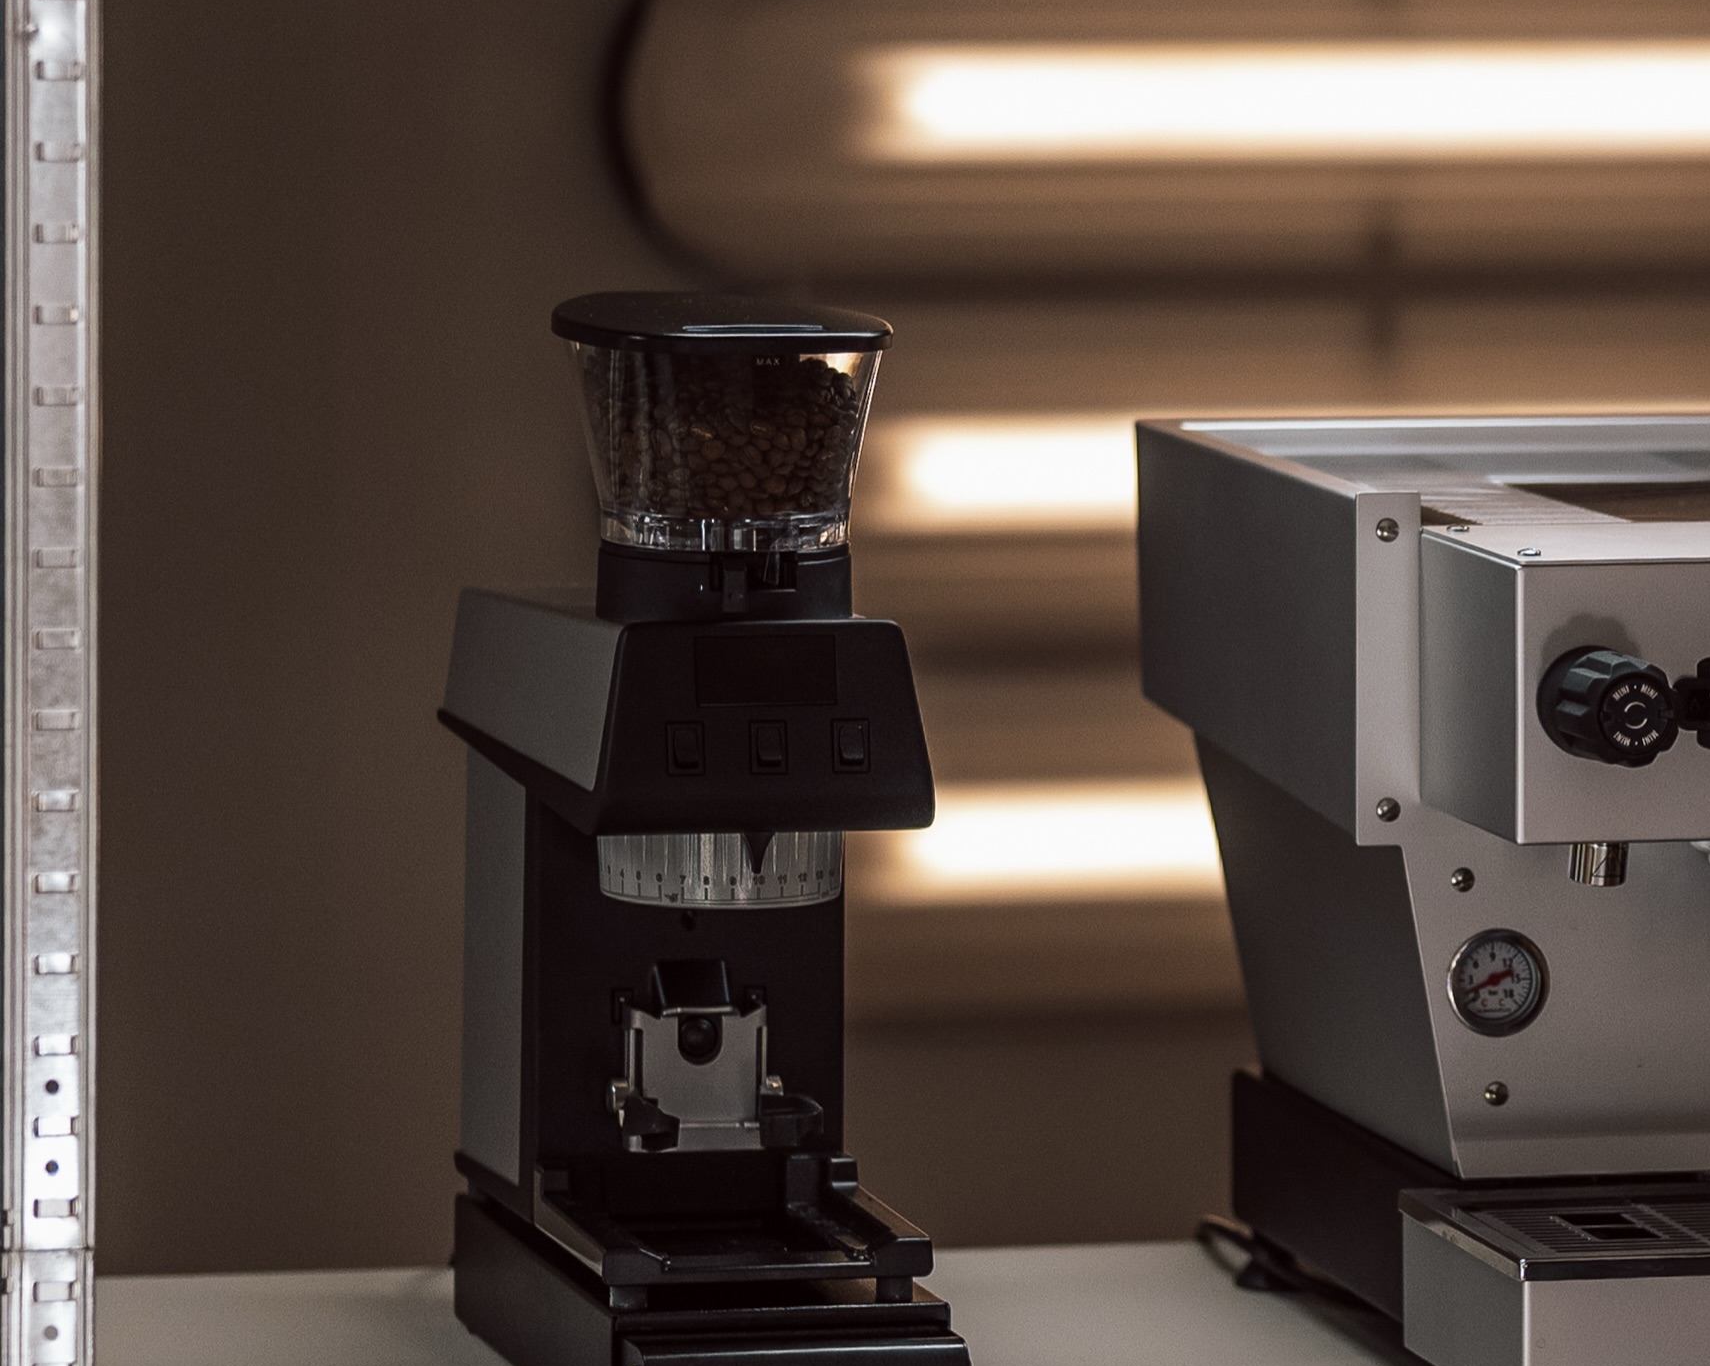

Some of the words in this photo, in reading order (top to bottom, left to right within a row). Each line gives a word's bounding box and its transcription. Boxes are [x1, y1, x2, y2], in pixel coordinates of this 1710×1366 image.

[756, 358, 780, 366] MAX
[1613, 685, 1630, 701] MINI
[1641, 684, 1658, 700] MINI
